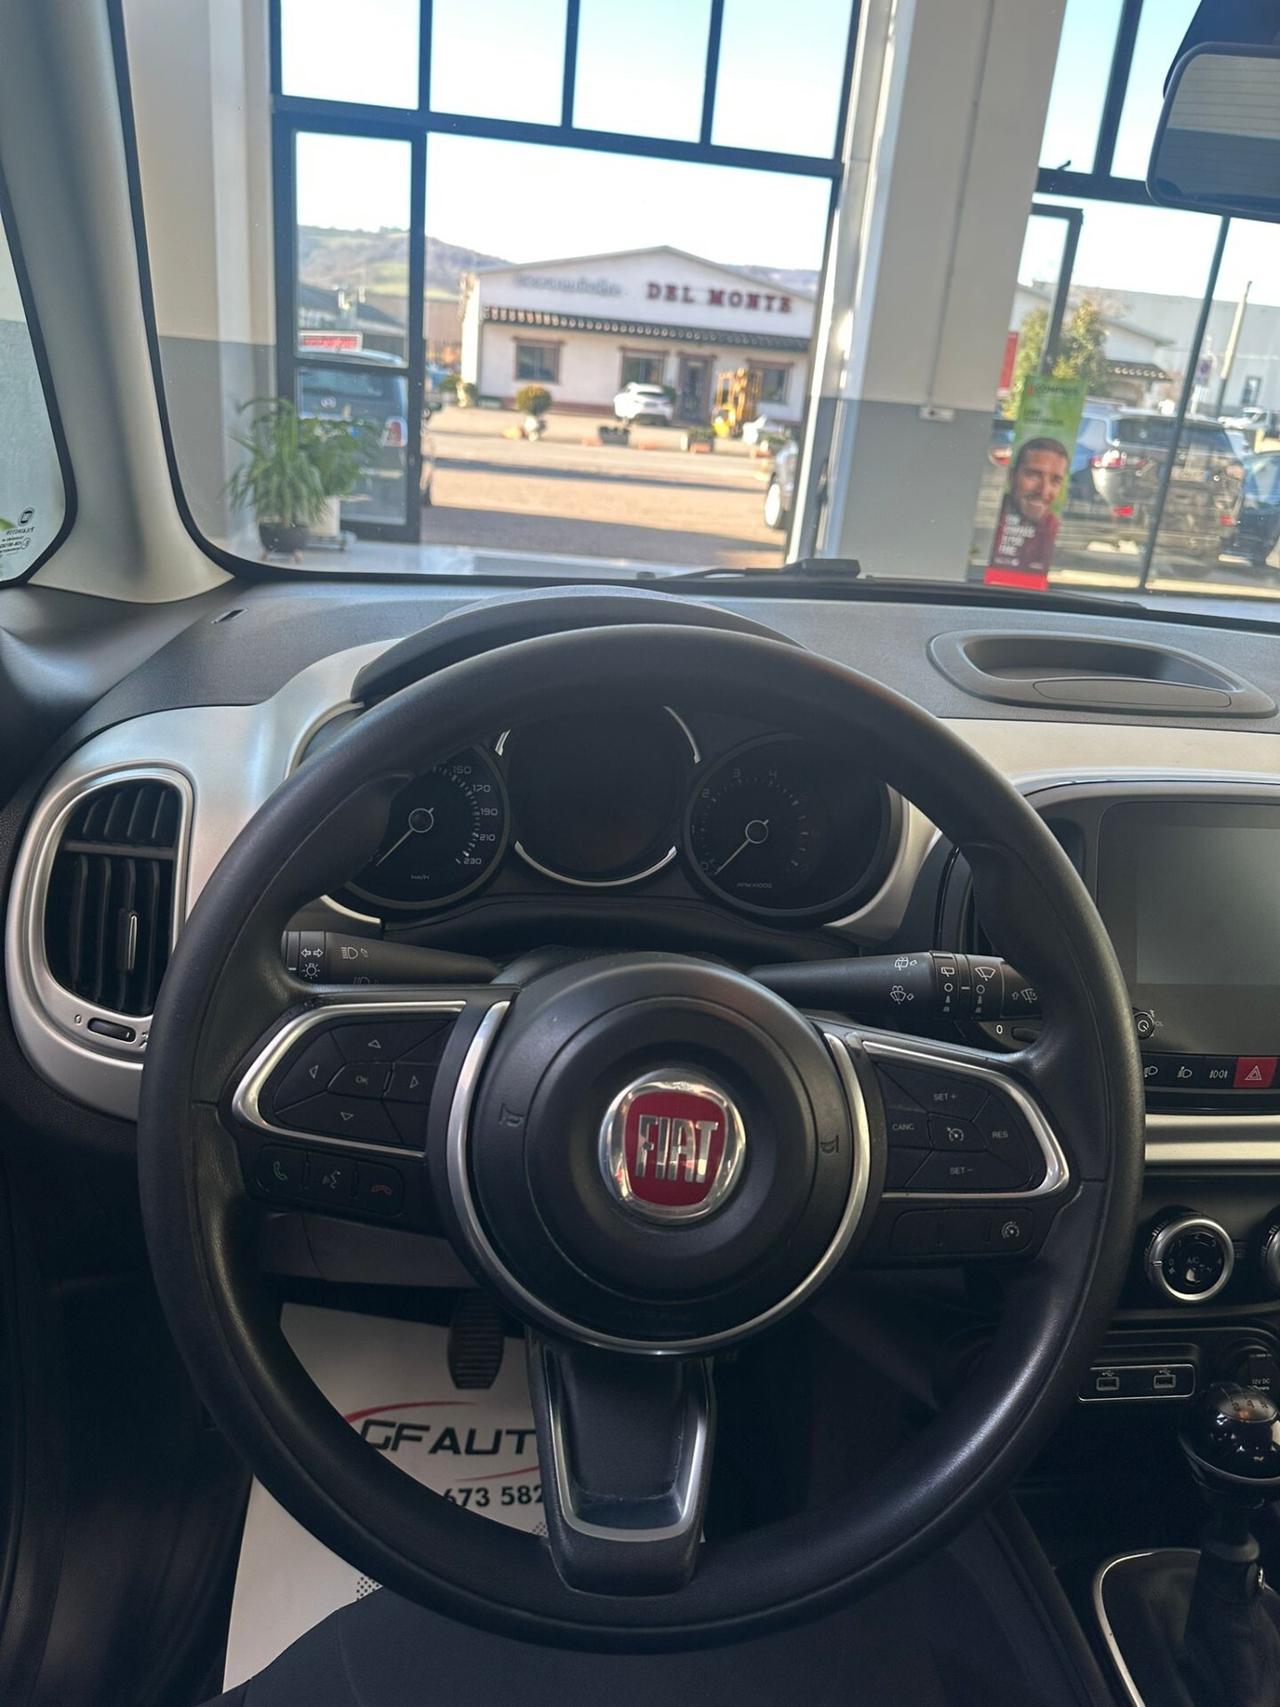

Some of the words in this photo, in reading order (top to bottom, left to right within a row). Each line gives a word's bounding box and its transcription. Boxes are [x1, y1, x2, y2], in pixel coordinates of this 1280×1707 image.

[646, 281, 695, 304] DEL
[707, 288, 793, 314] MONTE
[452, 765, 472, 775] 150
[472, 784, 492, 793] 170
[480, 807, 498, 817] 190
[479, 833, 496, 842] 210
[463, 857, 482, 866] 230
[933, 1093, 949, 1101] SET
[992, 1131, 1009, 1139] RES
[635, 1113, 720, 1184] FIAT
[950, 1167, 966, 1175] SET
